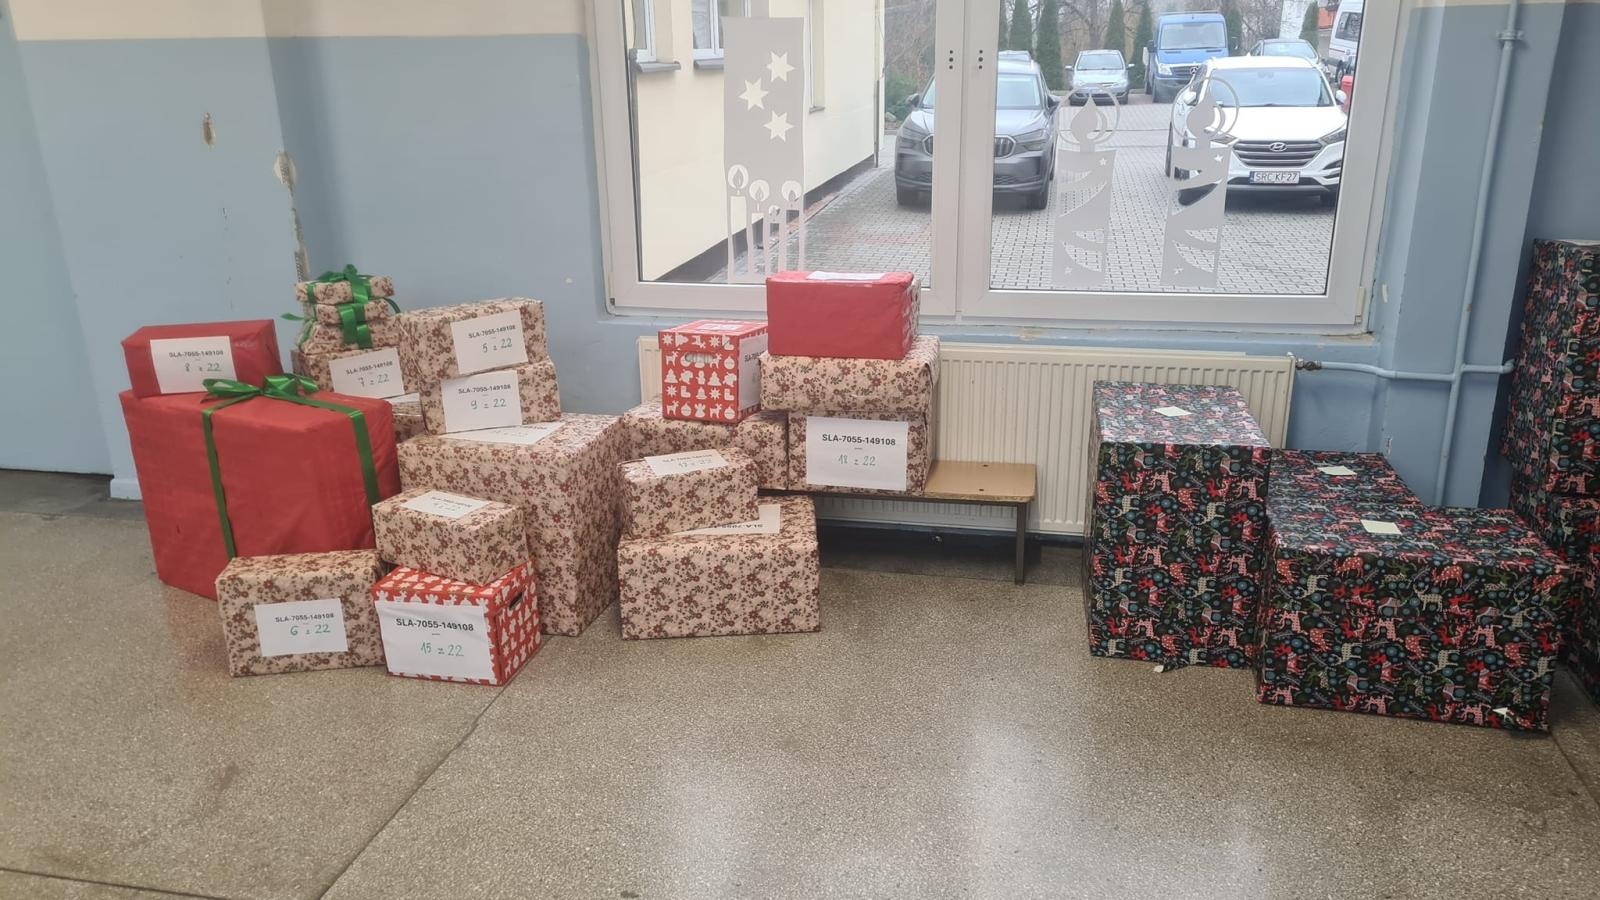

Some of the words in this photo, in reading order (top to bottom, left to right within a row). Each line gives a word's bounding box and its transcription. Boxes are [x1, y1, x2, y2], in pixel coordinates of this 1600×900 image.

[482, 342, 488, 353] 5
[501, 337, 513, 349] 22
[207, 362, 222, 372] 22
[358, 376, 365, 387] 7
[377, 373, 390, 384] 22
[471, 400, 478, 410] 9
[493, 398, 507, 408] 22
[822, 433, 896, 446] SLA-7055-149108
[862, 455, 876, 466] 22
[275, 613, 335, 623] SLA-7055-149108
[290, 625, 299, 636] 6
[315, 624, 331, 634] 22
[396, 618, 474, 631] SLA-7055-149108
[420, 642, 432, 654] 15
[448, 644, 464, 657] 22
